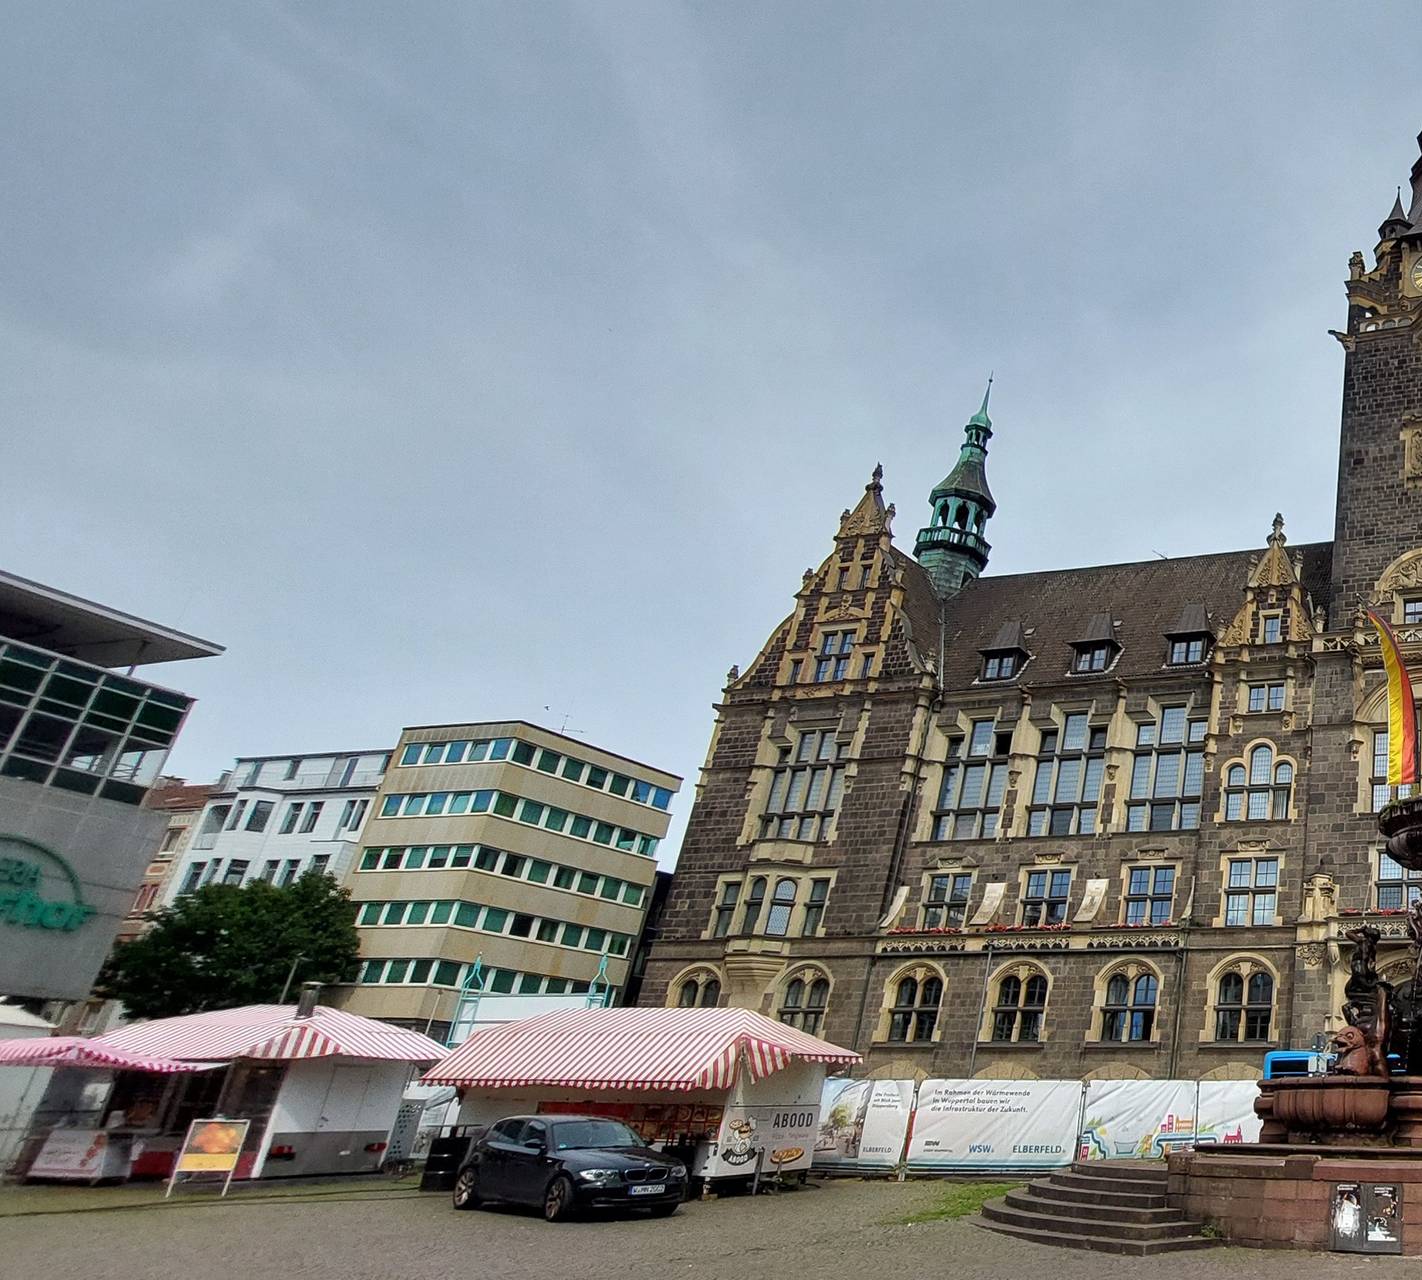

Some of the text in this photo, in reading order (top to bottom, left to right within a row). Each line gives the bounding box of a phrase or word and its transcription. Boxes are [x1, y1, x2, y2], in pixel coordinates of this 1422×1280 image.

[941, 1097, 975, 1105] Wuppertal
[1000, 1105, 1027, 1113] Zukunft.
[773, 1113, 813, 1128] ABOOD
